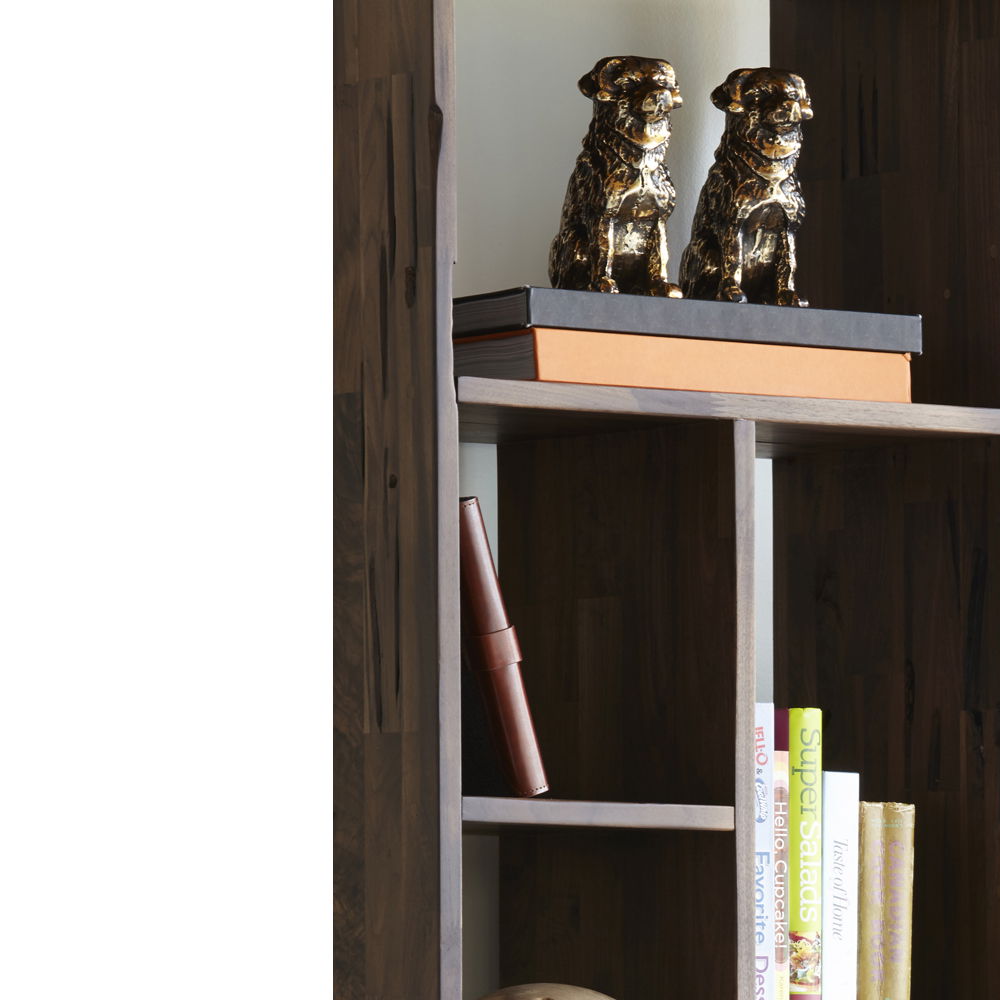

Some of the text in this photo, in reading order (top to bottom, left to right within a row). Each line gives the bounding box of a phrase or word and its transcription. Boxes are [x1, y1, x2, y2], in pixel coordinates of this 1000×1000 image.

[774, 801, 788, 948] Hello, Cupcake!
[833, 839, 849, 875] Taste
[755, 851, 770, 944] Favorite
[832, 895, 849, 941] Home
